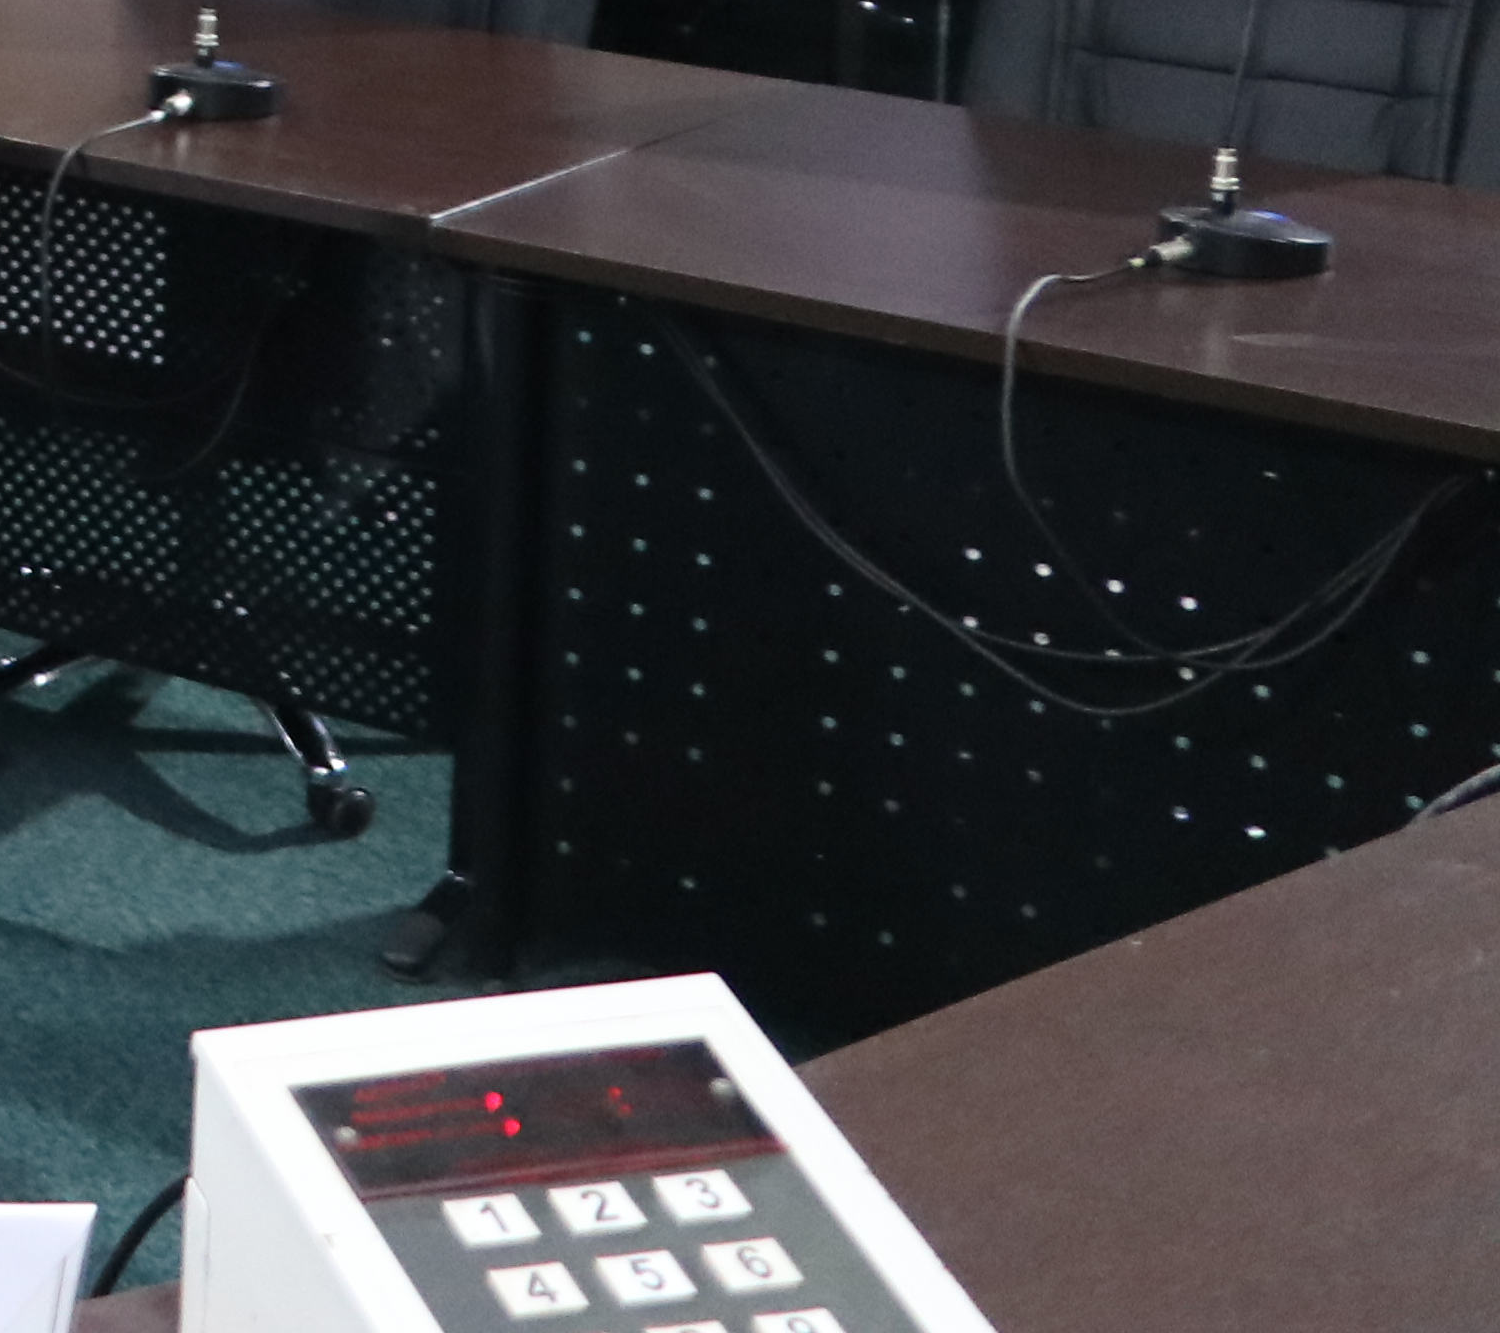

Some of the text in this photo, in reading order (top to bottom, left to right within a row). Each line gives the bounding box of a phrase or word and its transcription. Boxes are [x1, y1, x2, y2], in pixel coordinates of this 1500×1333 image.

[480, 1178, 721, 1234] 1 2 3
[527, 1245, 774, 1304] 4 5 6
